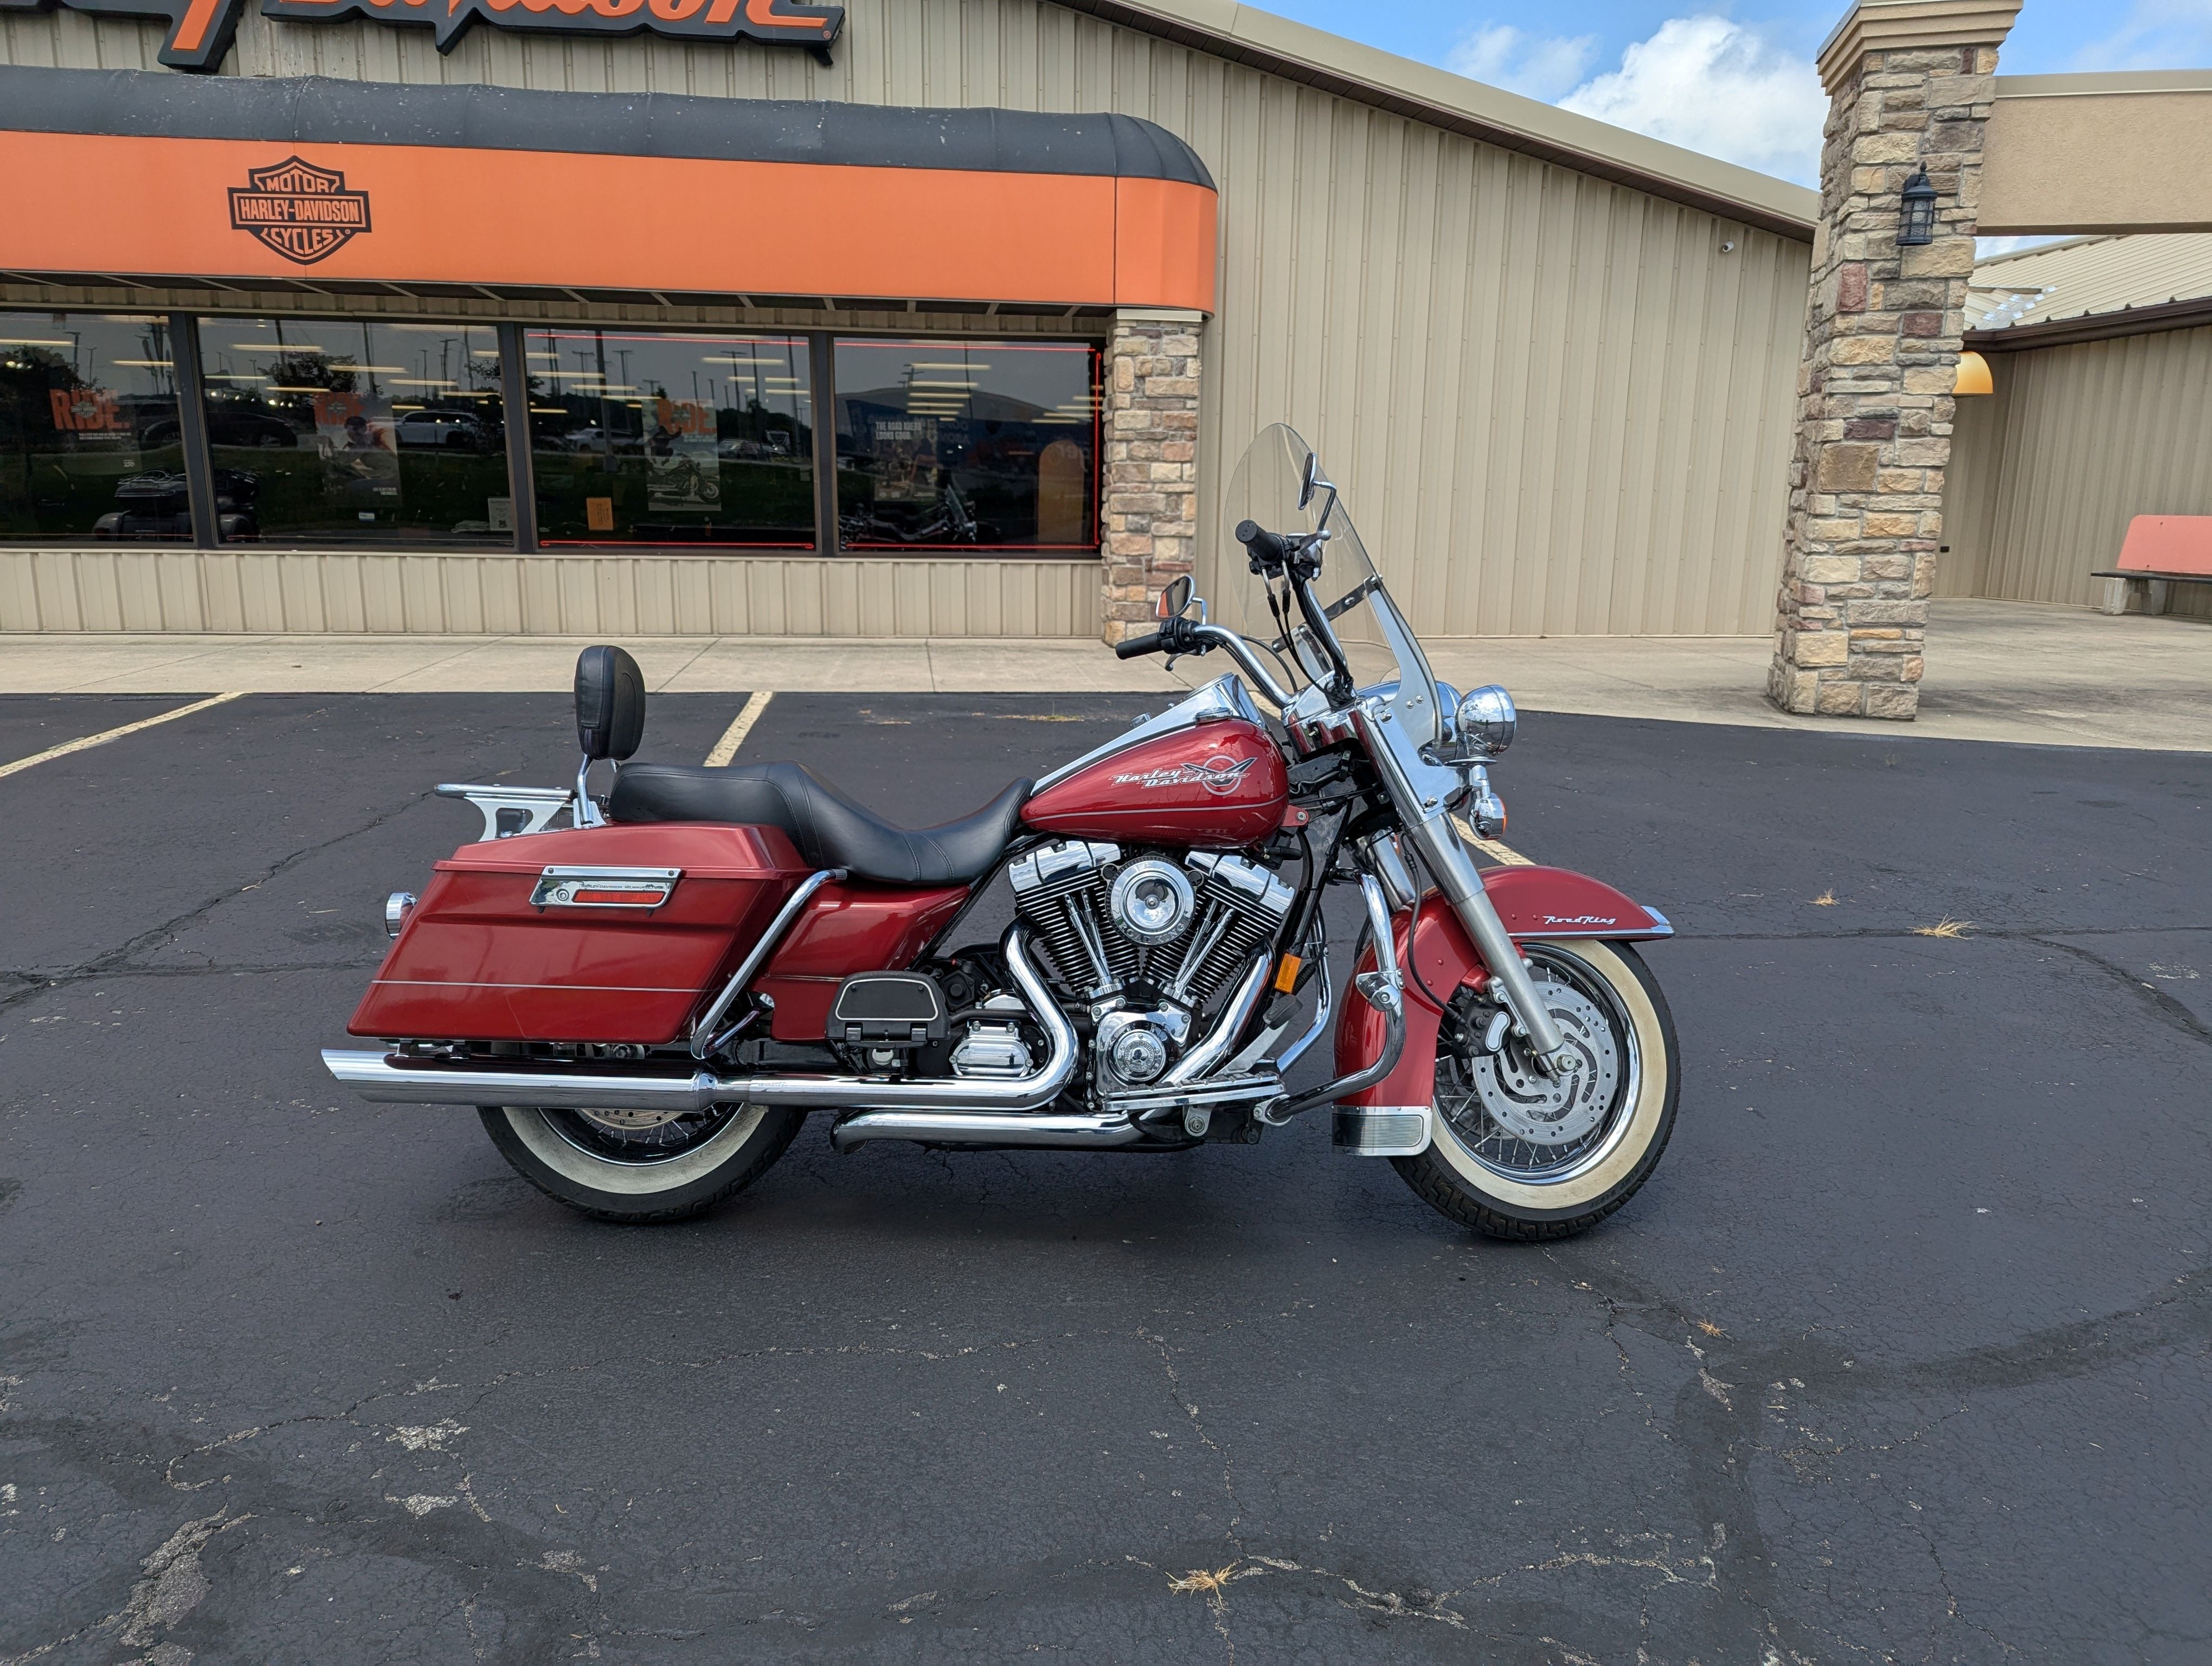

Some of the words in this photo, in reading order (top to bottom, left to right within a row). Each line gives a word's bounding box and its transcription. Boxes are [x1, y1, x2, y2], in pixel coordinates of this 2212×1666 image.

[266, 169, 329, 193] MOTOR
[240, 198, 359, 222] HARLEY-DAVIDSON
[271, 228, 333, 254] CYCLES
[1141, 772, 1249, 789] Davidson
[1155, 923, 1185, 943] KING
